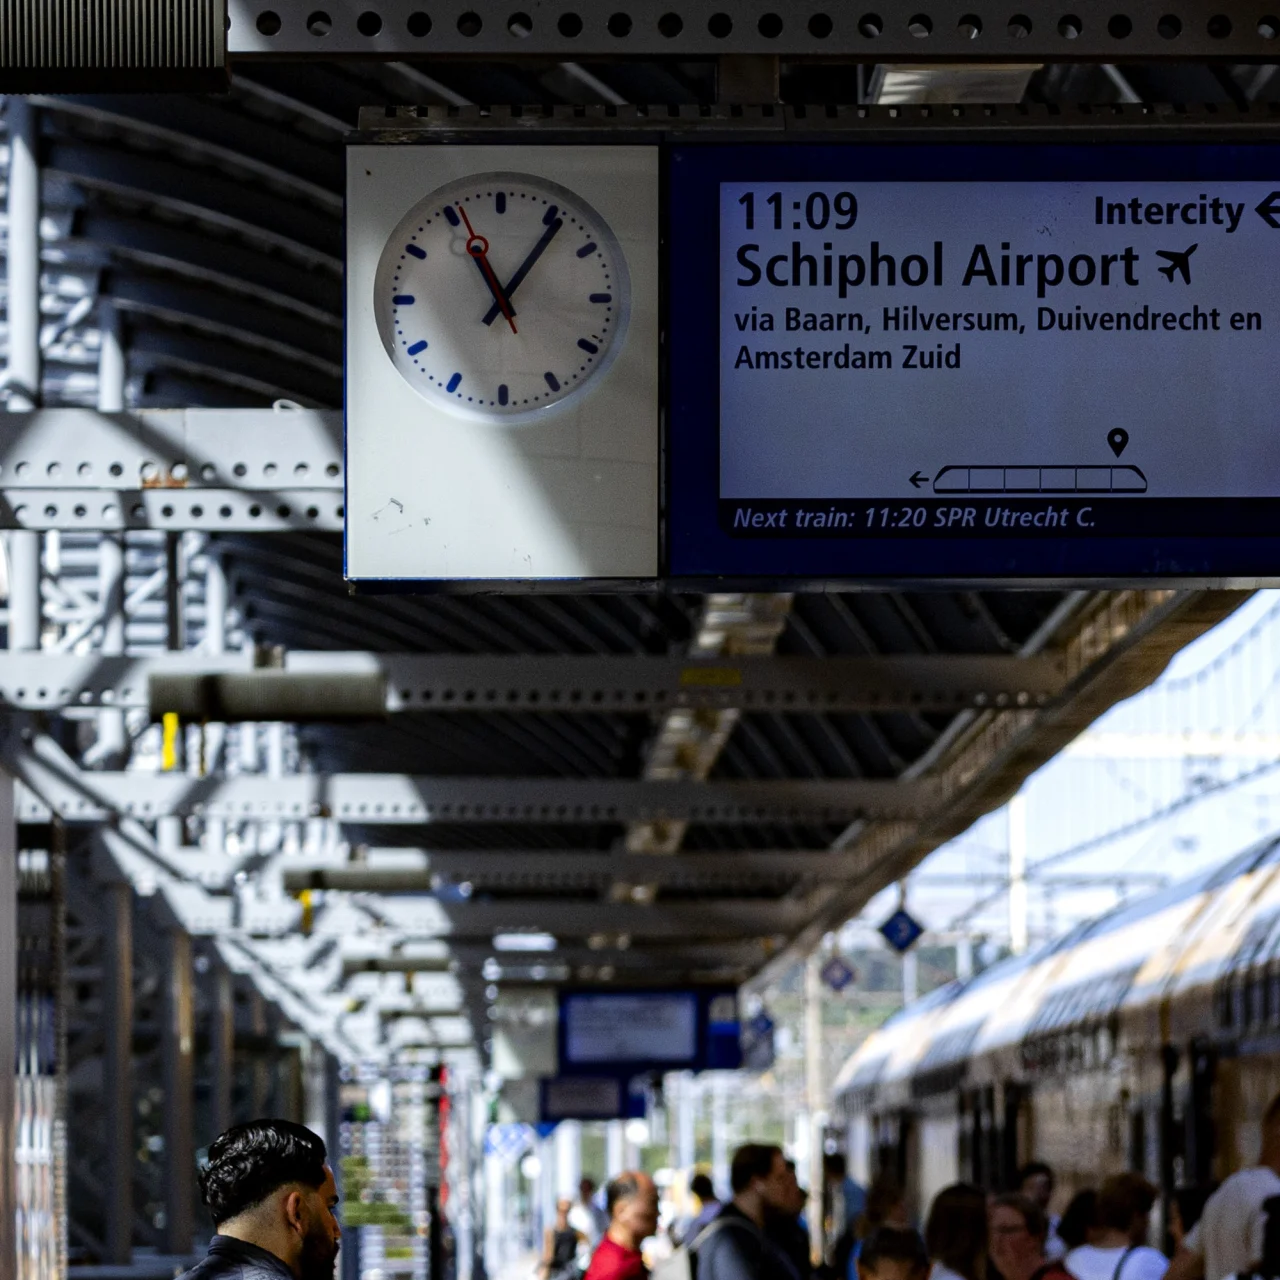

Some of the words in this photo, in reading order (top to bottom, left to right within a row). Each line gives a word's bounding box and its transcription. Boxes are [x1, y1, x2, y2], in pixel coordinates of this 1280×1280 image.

[738, 192, 858, 231] 11:09
[1095, 194, 1245, 233] Intercity
[736, 241, 943, 298] Schiphol
[962, 242, 1140, 298] Airport
[734, 306, 774, 332] via
[785, 307, 871, 335] Baarn,
[882, 305, 1026, 335] Hilversum,
[1037, 304, 1221, 331] Duivendrecht
[1229, 312, 1262, 331] en
[734, 344, 892, 370] Amsterdam
[902, 343, 961, 370] Zuid
[733, 508, 788, 528] Next
[795, 507, 856, 528] train:
[864, 507, 927, 528] 11:20
[933, 507, 976, 528] SPR
[984, 506, 1070, 528] Utrecht
[1076, 506, 1095, 528] C.
